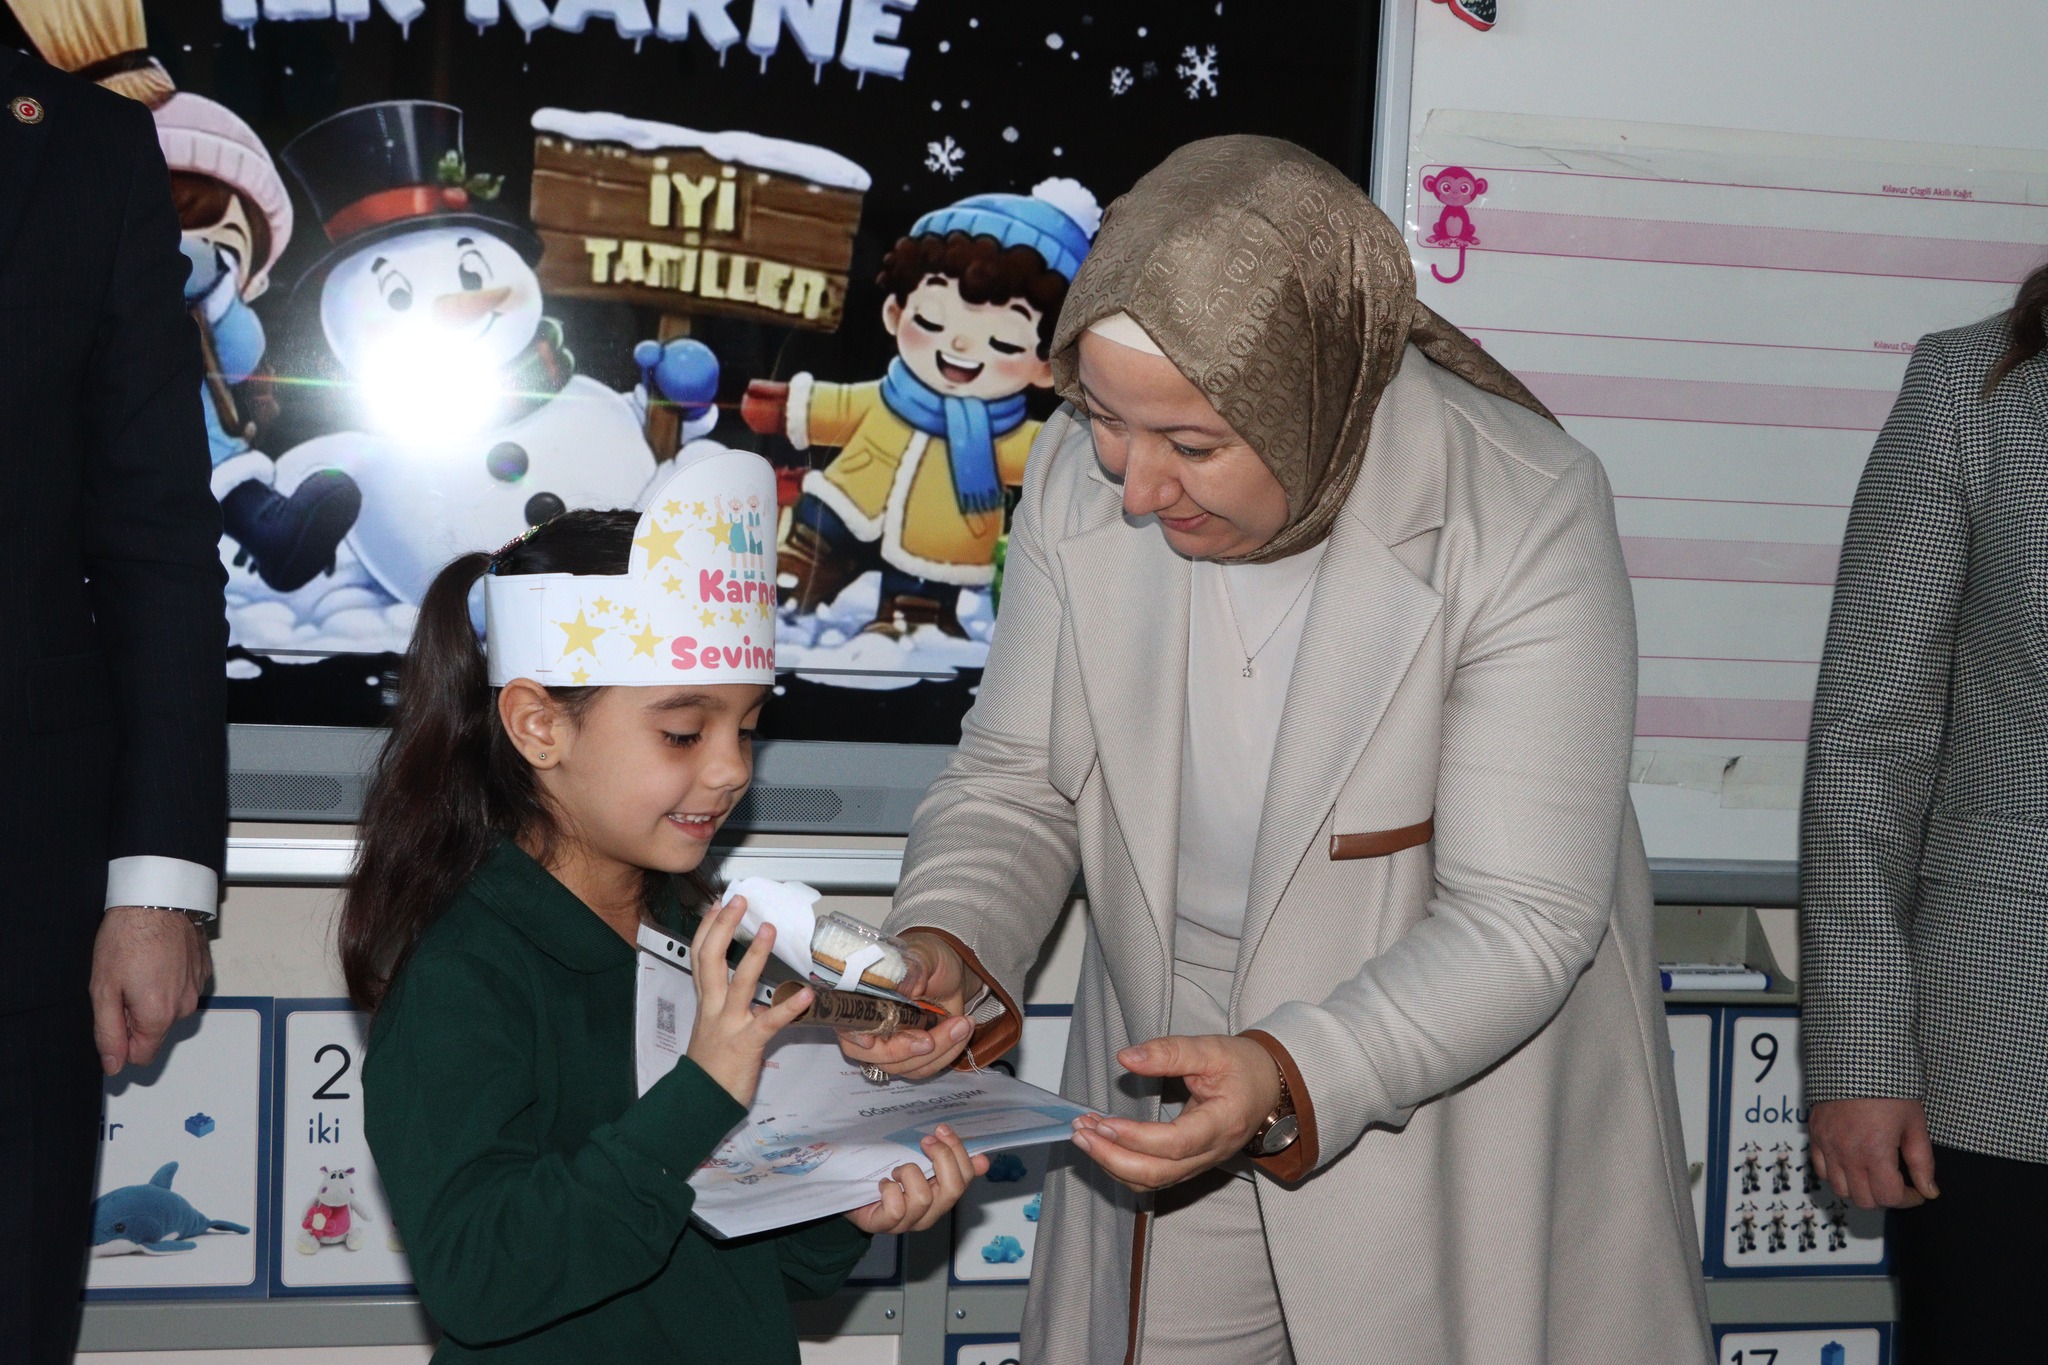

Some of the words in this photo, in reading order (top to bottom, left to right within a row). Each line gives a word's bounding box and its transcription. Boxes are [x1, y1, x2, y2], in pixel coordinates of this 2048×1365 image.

[1882, 184, 1908, 195] Kılavuz
[1909, 186, 1932, 197] Çizgili
[1953, 189, 1973, 199] Kağıt
[699, 568, 776, 607] Karne
[671, 635, 776, 670] Sevinc
[312, 1043, 351, 1100] 2
[1751, 1032, 1779, 1084] 9
[858, 1099, 927, 1118] ÖĞRENCİ
[928, 1088, 987, 1107] GELİŞİM
[1745, 1094, 1810, 1124] doku
[100, 1114, 125, 1142] ir
[308, 1111, 340, 1144] iki
